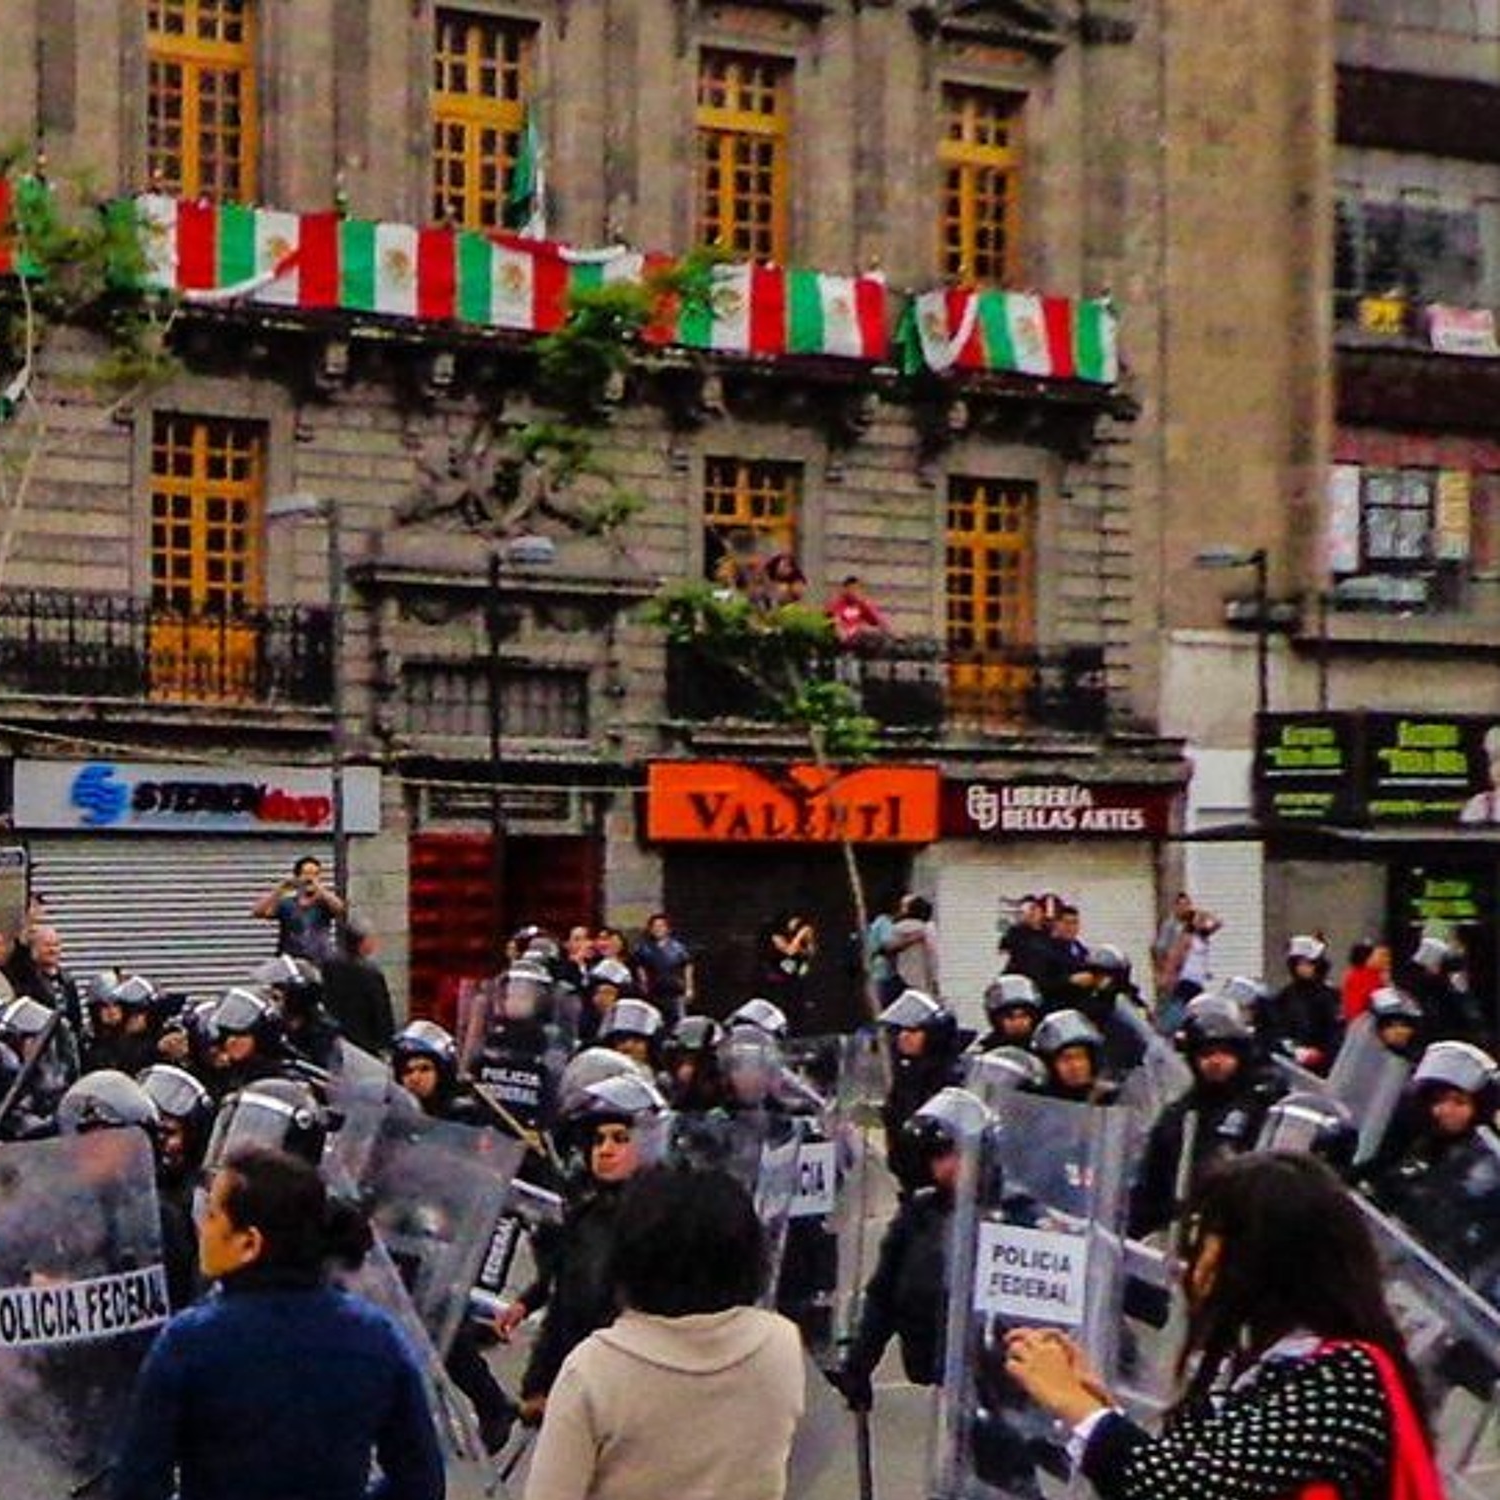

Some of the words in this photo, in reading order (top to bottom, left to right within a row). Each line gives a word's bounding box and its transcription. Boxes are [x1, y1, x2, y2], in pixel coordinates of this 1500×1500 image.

[1079, 808, 1146, 831] ARTES
[992, 1244, 1072, 1274] POLICIA
[86, 1272, 169, 1332] FEDERAL
[989, 1271, 1068, 1303] FEDERAL
